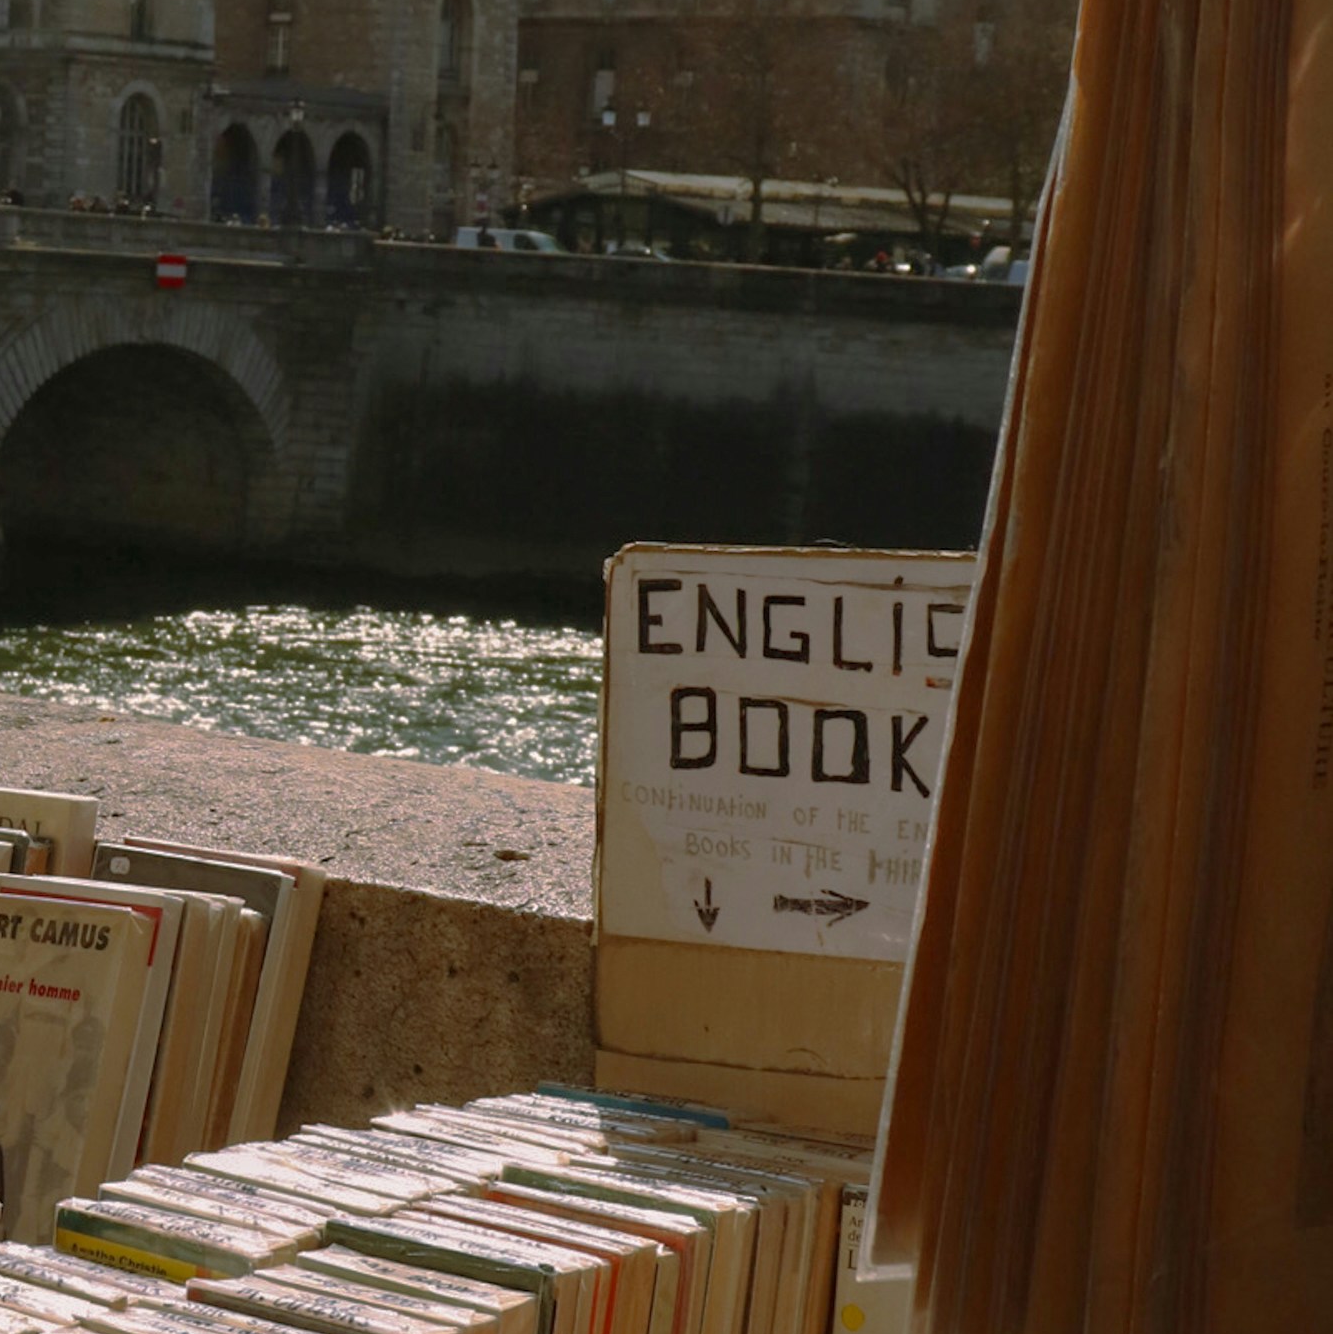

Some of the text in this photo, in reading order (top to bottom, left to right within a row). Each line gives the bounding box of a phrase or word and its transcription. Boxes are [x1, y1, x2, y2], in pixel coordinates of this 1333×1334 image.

[638, 577, 967, 686] ENGLiS
[669, 686, 930, 799] BOOK
[793, 806, 819, 827] OF
[772, 845, 792, 866] IN
[29, 917, 111, 951] CAMUS
[28, 978, 81, 1002] homme
